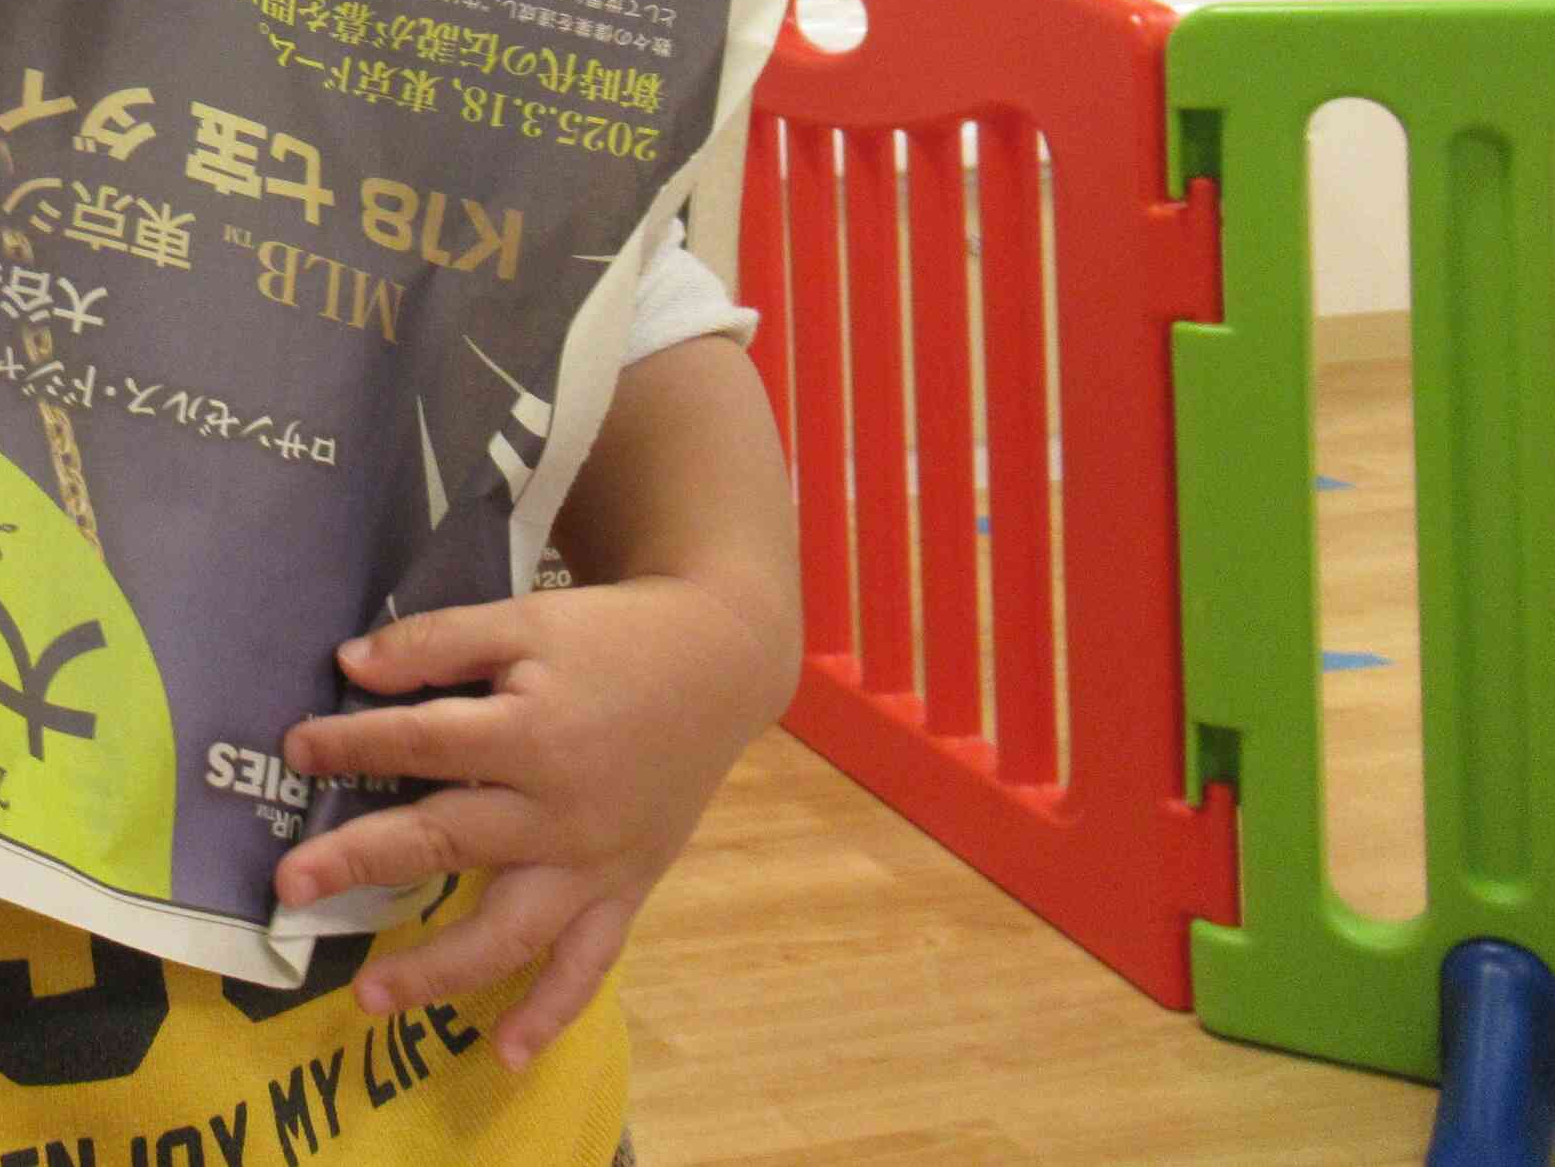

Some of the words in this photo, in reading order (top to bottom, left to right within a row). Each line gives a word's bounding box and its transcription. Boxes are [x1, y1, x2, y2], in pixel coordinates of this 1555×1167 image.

[258, 23, 660, 162] 2025.3.18、東京ドーム。
[186, 100, 333, 226] 七宝
[360, 177, 523, 280] K18
[204, 741, 307, 809] RIES
[268, 1046, 345, 1167] MY
